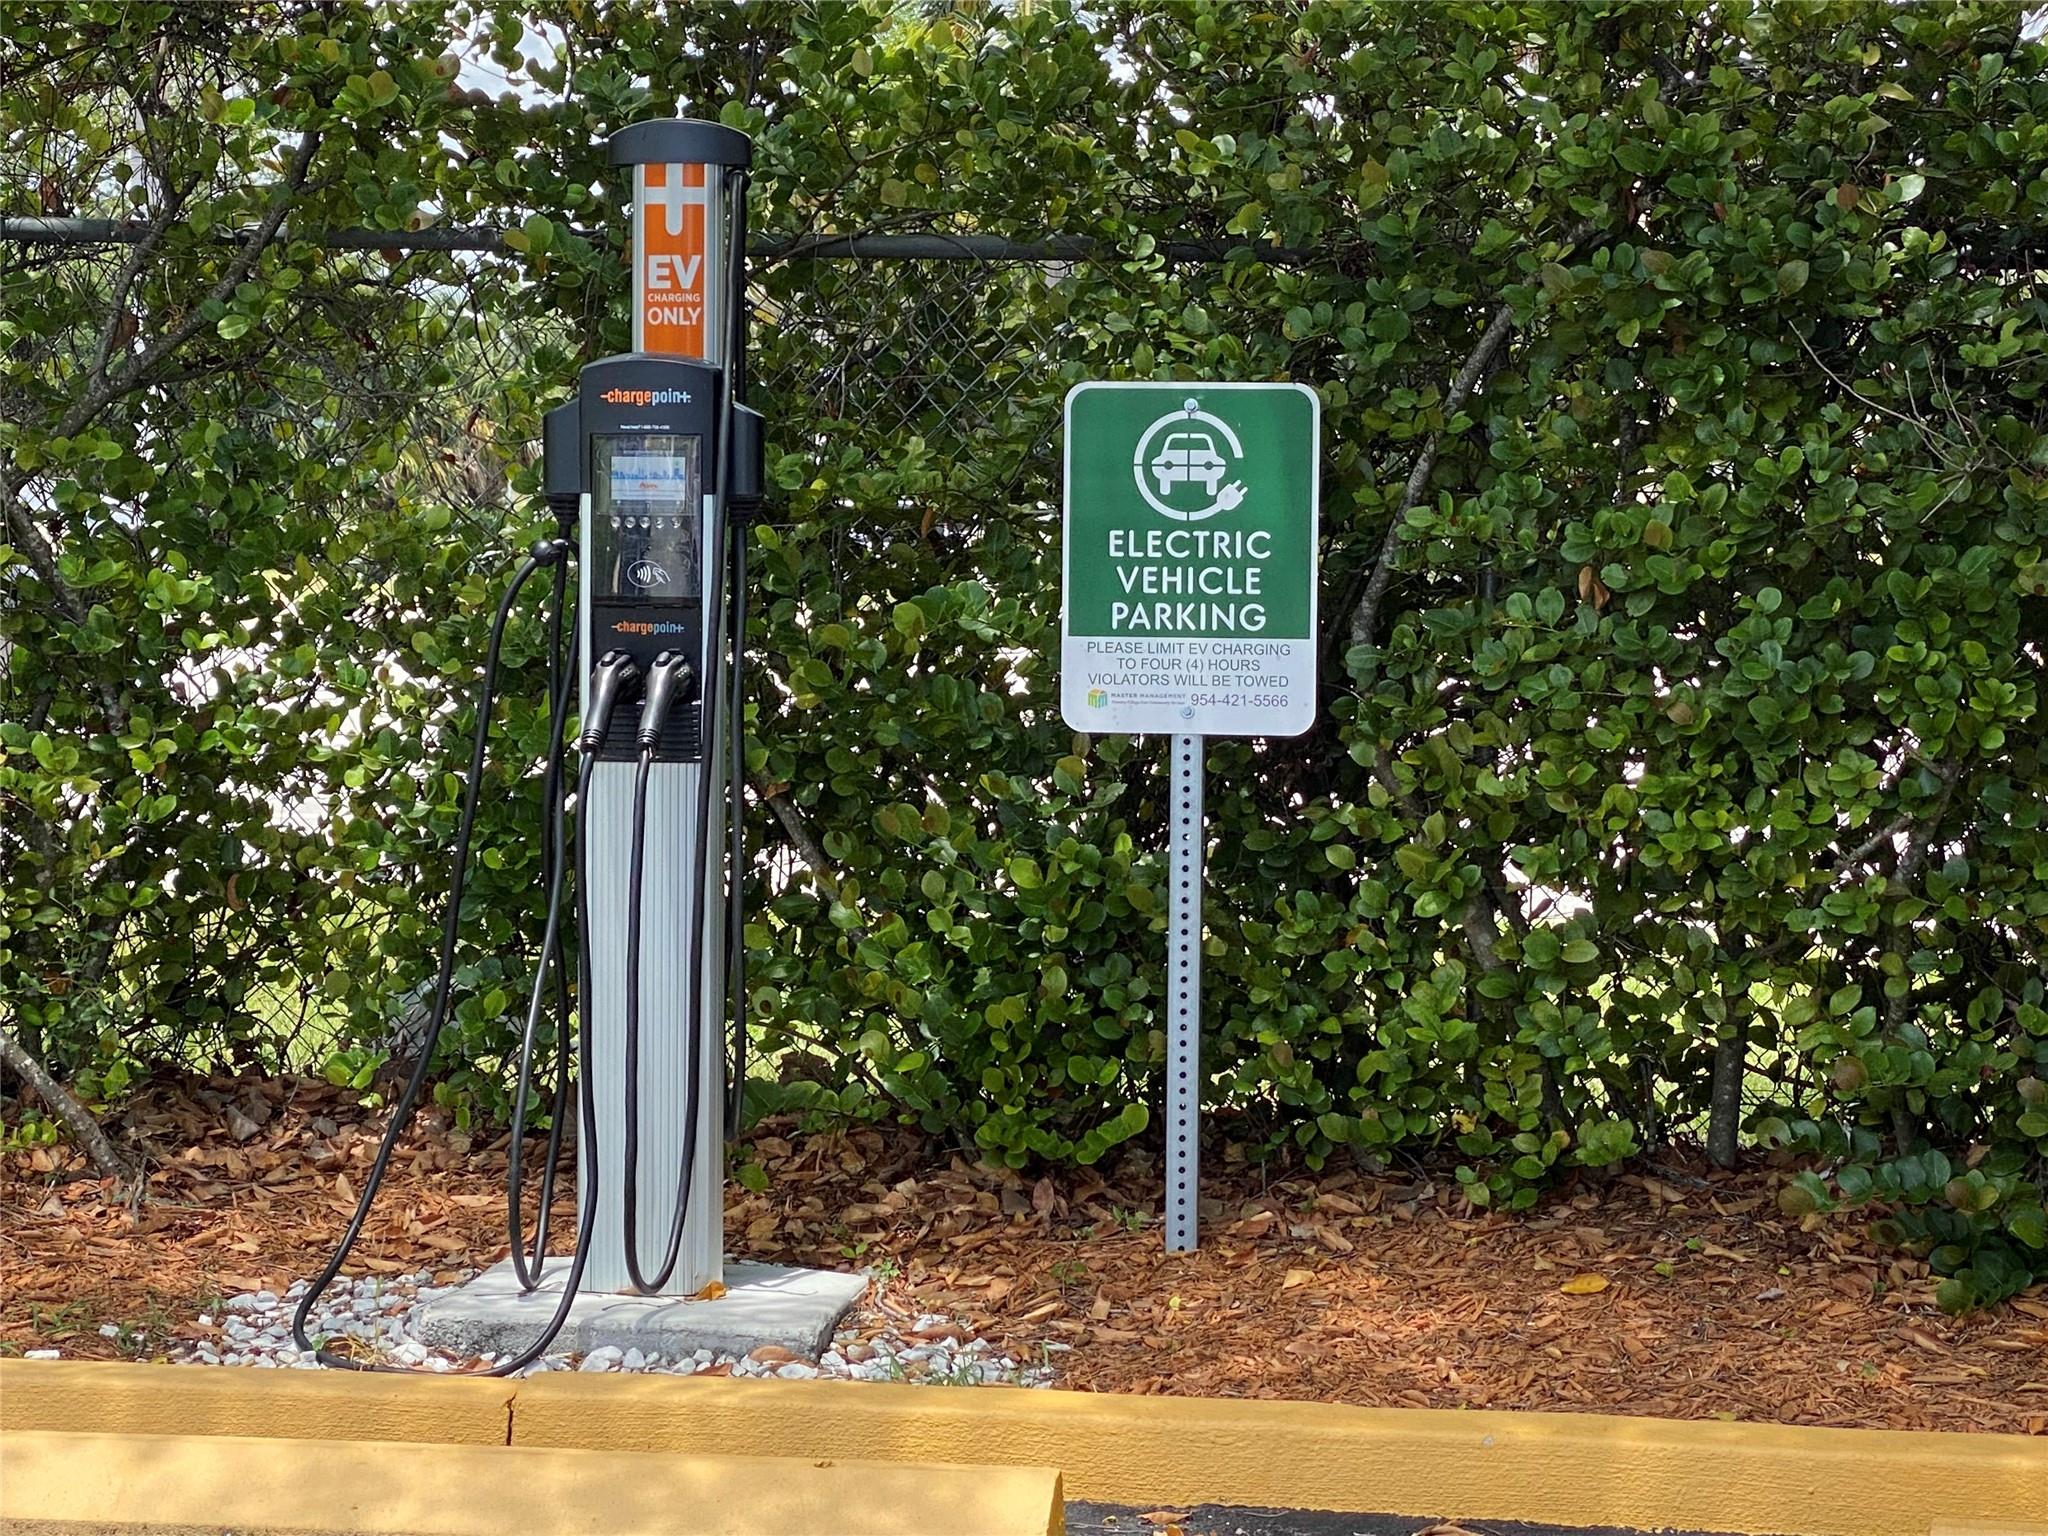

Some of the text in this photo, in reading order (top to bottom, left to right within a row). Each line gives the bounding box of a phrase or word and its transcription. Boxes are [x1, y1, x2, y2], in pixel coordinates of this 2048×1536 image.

[648, 255, 702, 289] EV
[647, 293, 700, 303] CHARGING
[647, 307, 701, 326] ONLY
[1108, 529, 1272, 559] ELECTRIC
[1116, 566, 1262, 595] VEHICLE
[1111, 602, 1267, 632] PARKING
[1087, 641, 1291, 656] PLEASE LIMIT EV CHARGING
[1117, 658, 1260, 672] TO FOUR (4) HOURS
[1088, 673, 1289, 688] VIOLATORS WILL BE TOWED
[1190, 693, 1289, 708] 954-421-5566
